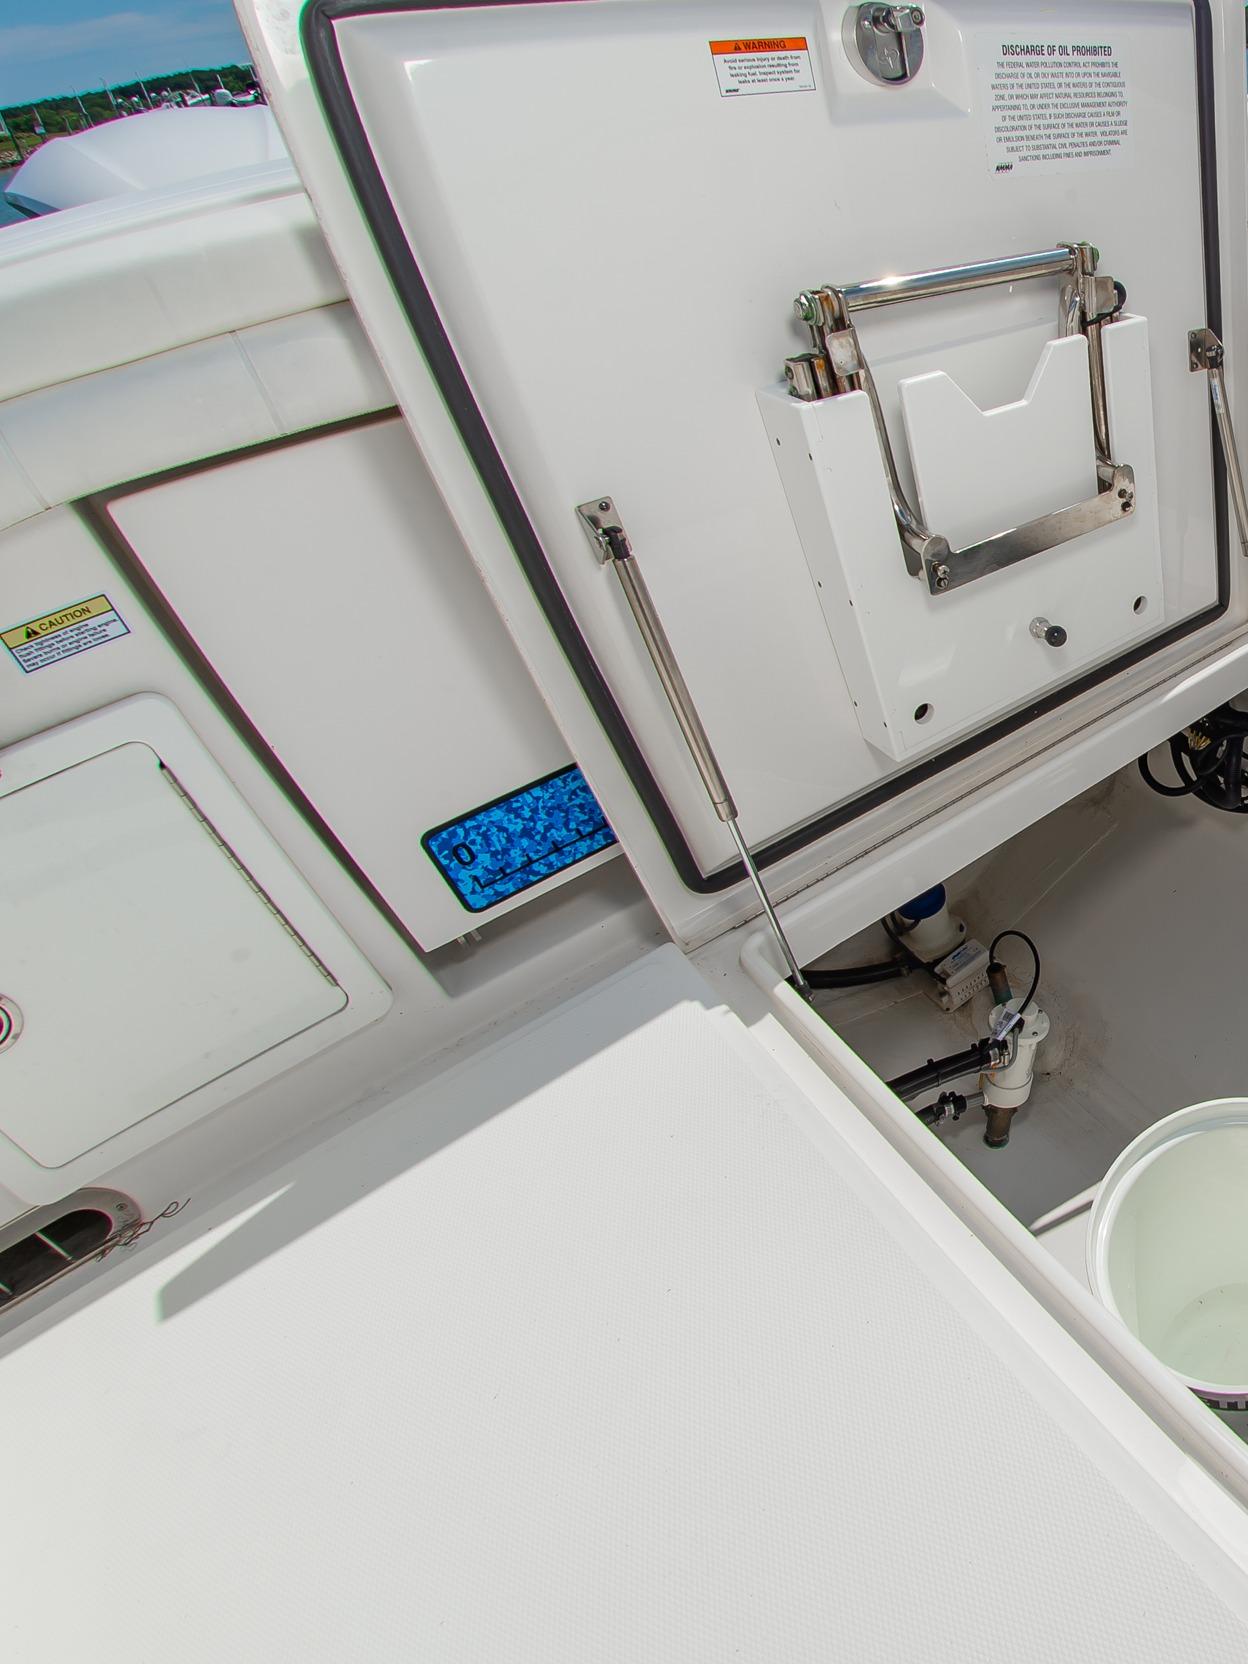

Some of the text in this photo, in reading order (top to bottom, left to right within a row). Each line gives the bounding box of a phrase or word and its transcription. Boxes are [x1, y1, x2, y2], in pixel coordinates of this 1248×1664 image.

[743, 40, 786, 50] WARNING
[1002, 45, 1112, 56] DISCHARGE OF OIL PROHIBITED
[39, 606, 91, 631] CAUTION
[452, 842, 476, 866] 0
